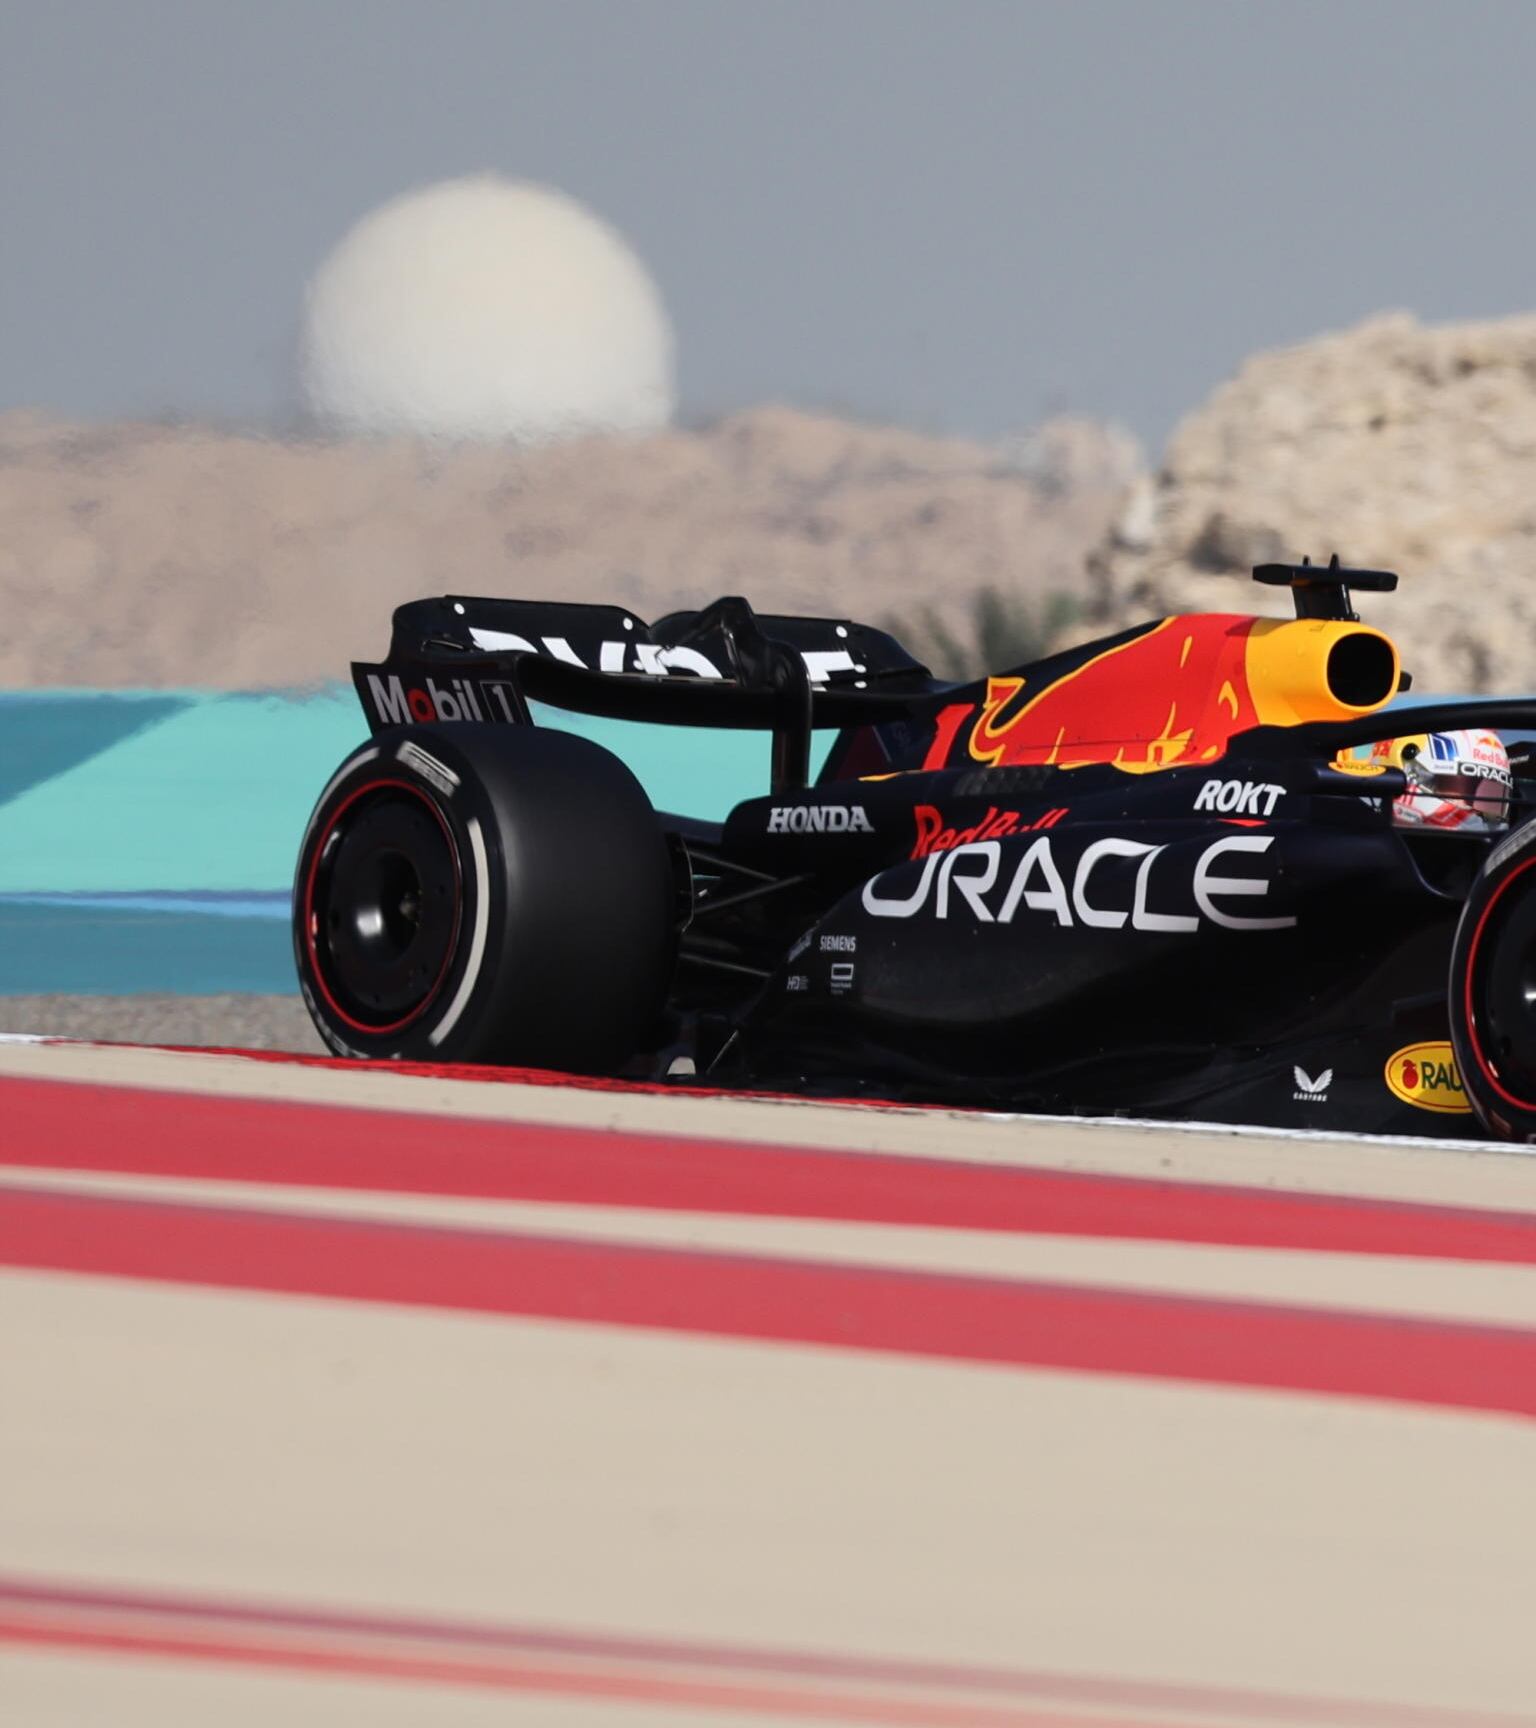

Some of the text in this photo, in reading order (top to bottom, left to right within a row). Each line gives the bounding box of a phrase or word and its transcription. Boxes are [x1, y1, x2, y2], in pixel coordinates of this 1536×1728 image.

[367, 675, 514, 724] Mobil 1
[1460, 763, 1514, 790] ORACL
[1193, 779, 1287, 816] ROKT
[766, 805, 875, 833] HONDA
[819, 934, 856, 952] SIEMENS
[1420, 1061, 1464, 1092] RAU
